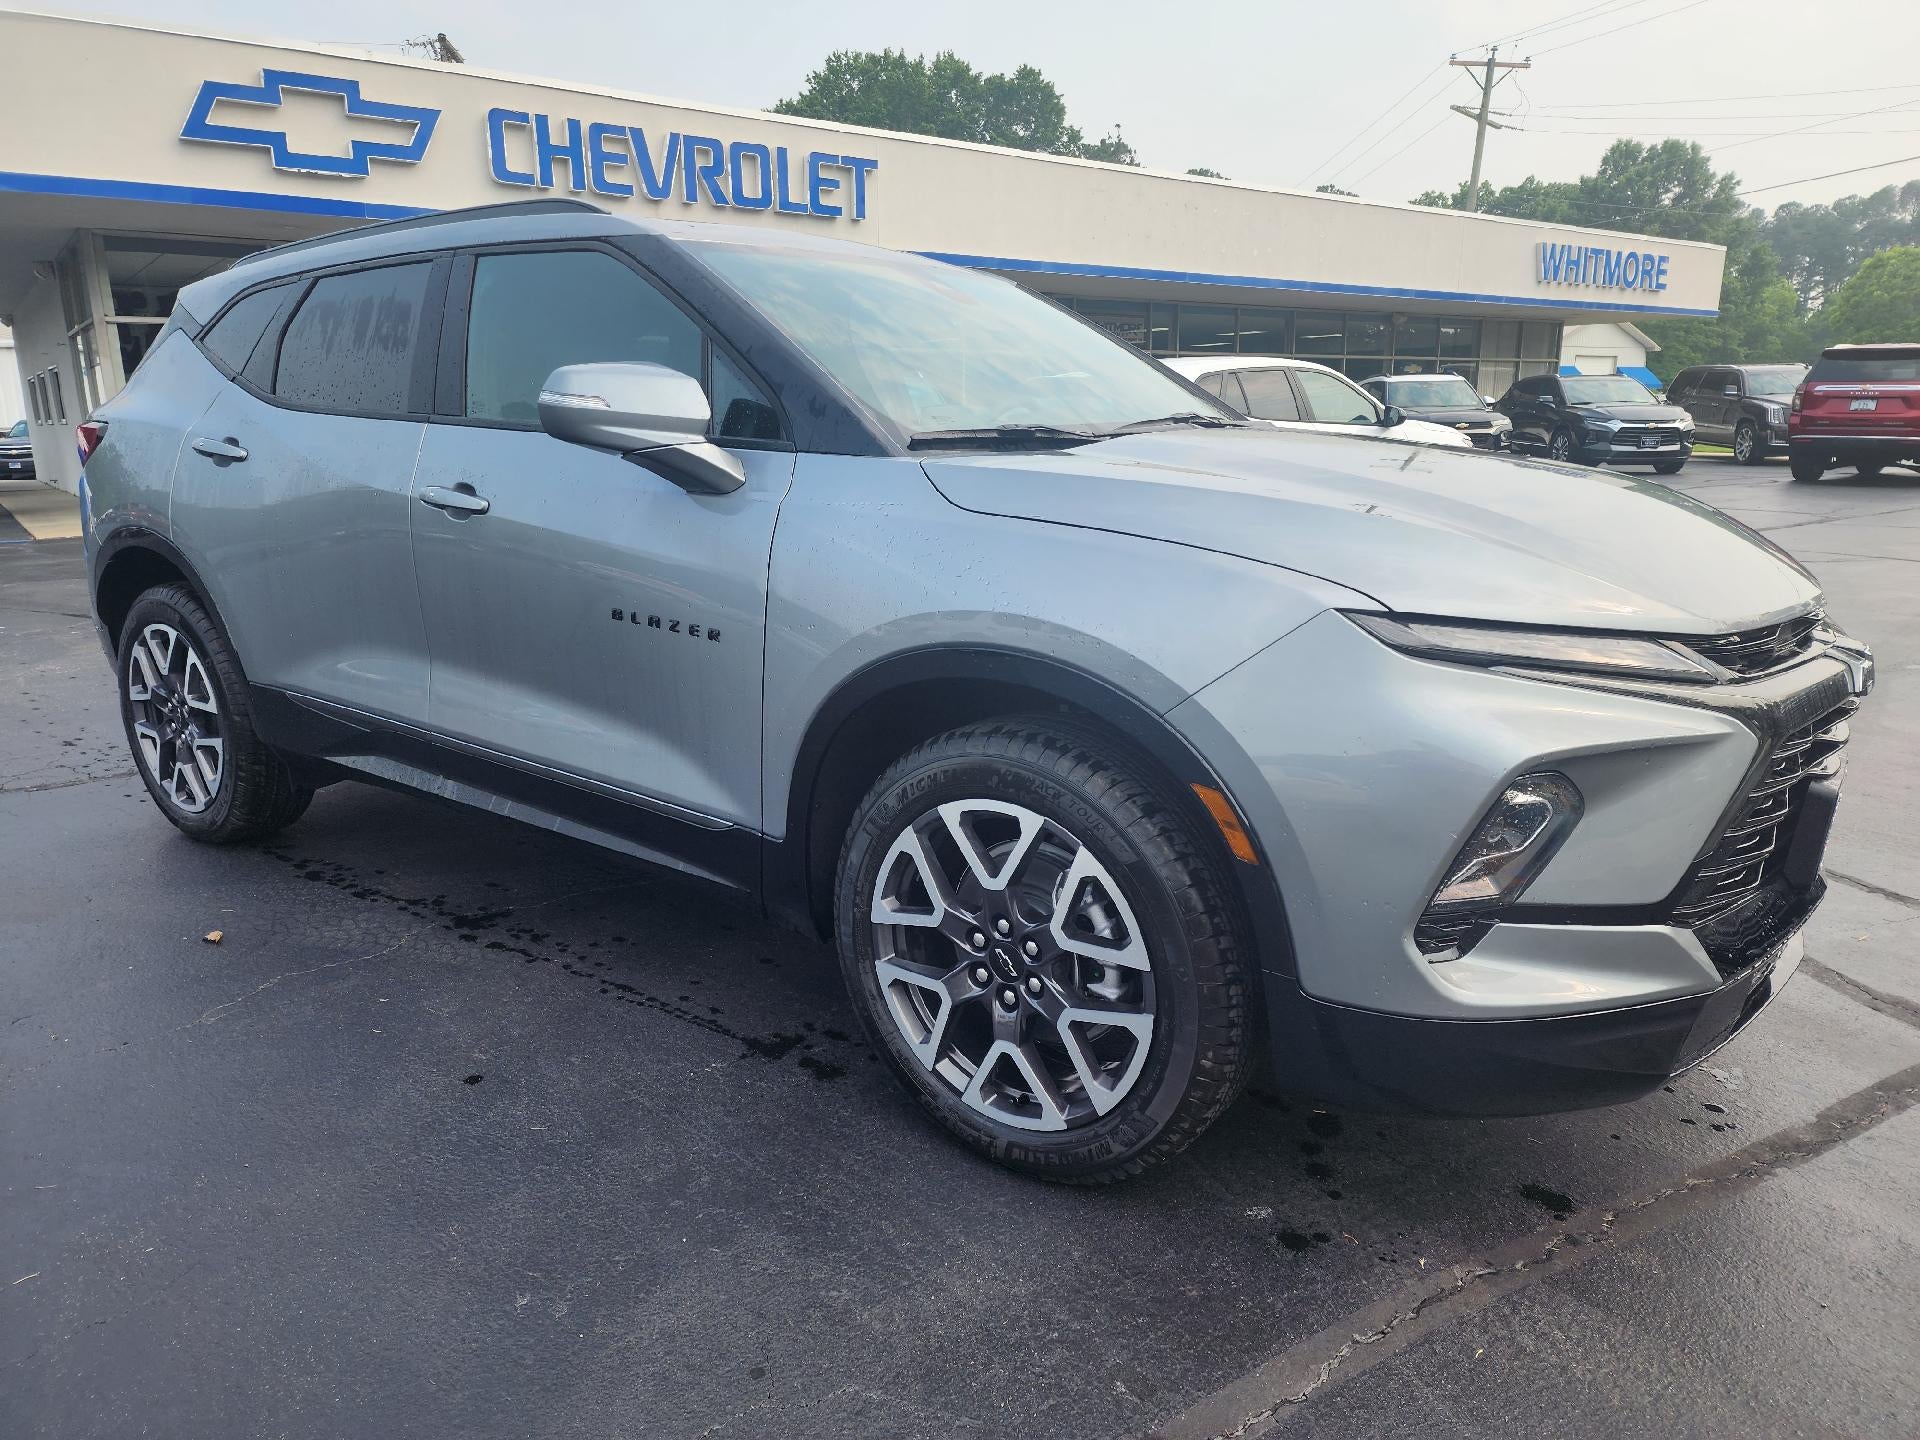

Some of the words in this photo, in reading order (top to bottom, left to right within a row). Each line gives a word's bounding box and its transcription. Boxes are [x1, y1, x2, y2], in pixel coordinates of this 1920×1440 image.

[487, 107, 879, 221] CHEVROLET
[1540, 241, 1670, 291] WHITMORE
[611, 607, 721, 642] BLAZER
